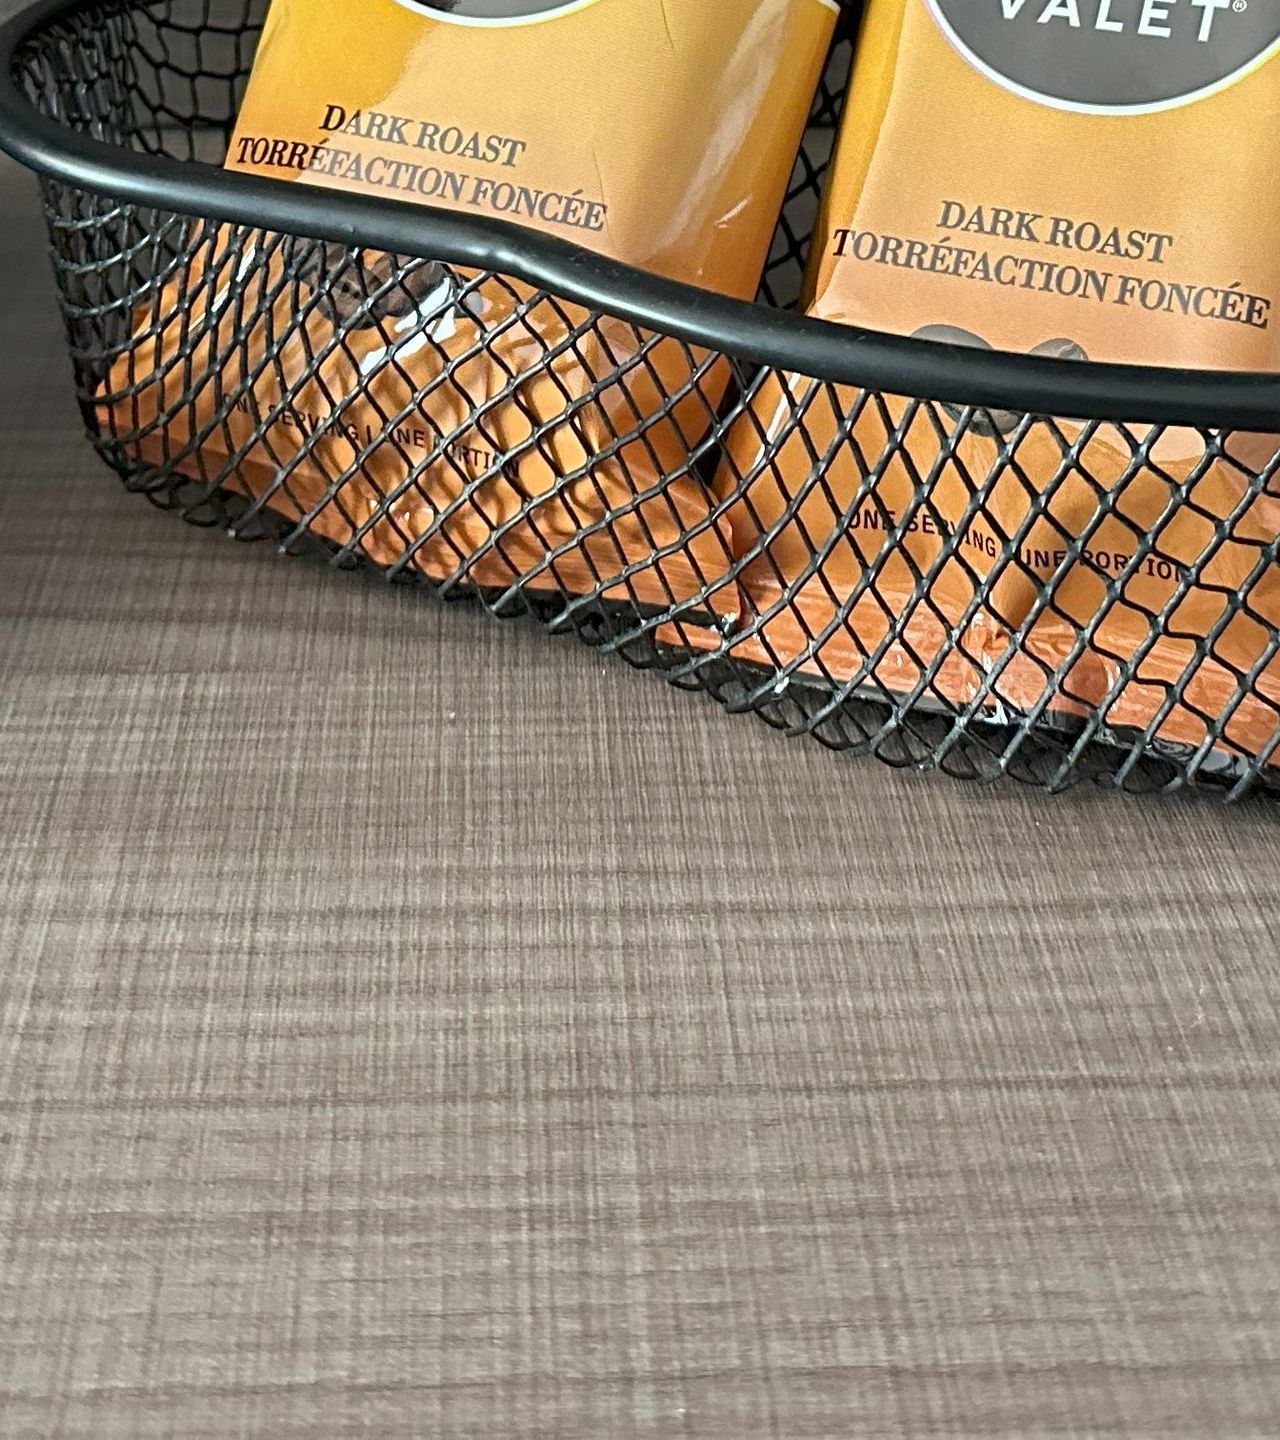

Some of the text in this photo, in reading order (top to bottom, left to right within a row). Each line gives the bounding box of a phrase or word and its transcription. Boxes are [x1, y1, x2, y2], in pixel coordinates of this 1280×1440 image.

[318, 103, 528, 169] DARK ROAST
[235, 136, 610, 233] TORRÉFACTION FONCÉE
[936, 199, 1175, 264] DARK ROAST
[832, 227, 1272, 330] TORRÉFACTION FONCÉE
